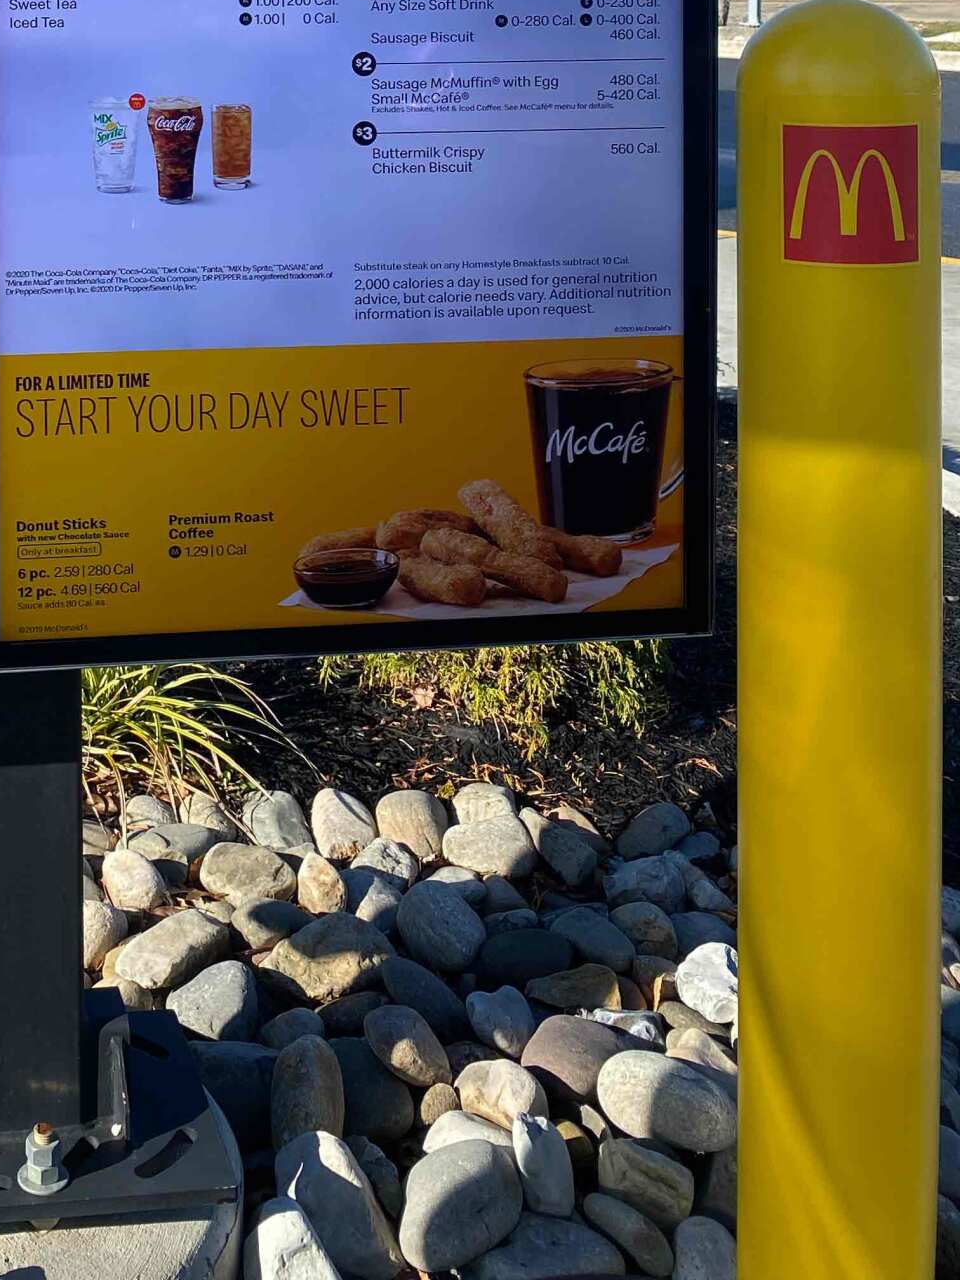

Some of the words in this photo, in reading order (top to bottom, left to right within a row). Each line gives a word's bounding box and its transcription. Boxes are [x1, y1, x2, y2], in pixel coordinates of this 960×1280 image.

[370, 0, 396, 14] Any
[398, 0, 426, 11] Size
[9, 16, 38, 29] Iced
[40, 16, 65, 28] Tea
[370, 32, 427, 46] Sausage
[430, 30, 474, 43] Biscuit
[609, 28, 634, 40] 460
[636, 27, 660, 40] Cal.
[354, 277, 390, 292] 2,000
[392, 276, 444, 290] calories
[446, 278, 455, 288] a
[457, 276, 481, 290] day
[483, 275, 494, 287] is
[496, 274, 528, 287] used
[530, 273, 549, 286] for
[551, 272, 600, 288] general
[603, 271, 657, 284] nutrition
[15, 376, 42, 392] FOR
[44, 375, 55, 391] A
[58, 373, 114, 390] LIMITED
[116, 372, 150, 389] TIME
[15, 396, 118, 438] START
[127, 393, 217, 433] YOUR
[229, 390, 289, 430] DAY
[300, 387, 410, 428] SWEET
[545, 420, 646, 464] McCafé
[16, 519, 59, 532] Donut
[62, 517, 107, 531] Sticks
